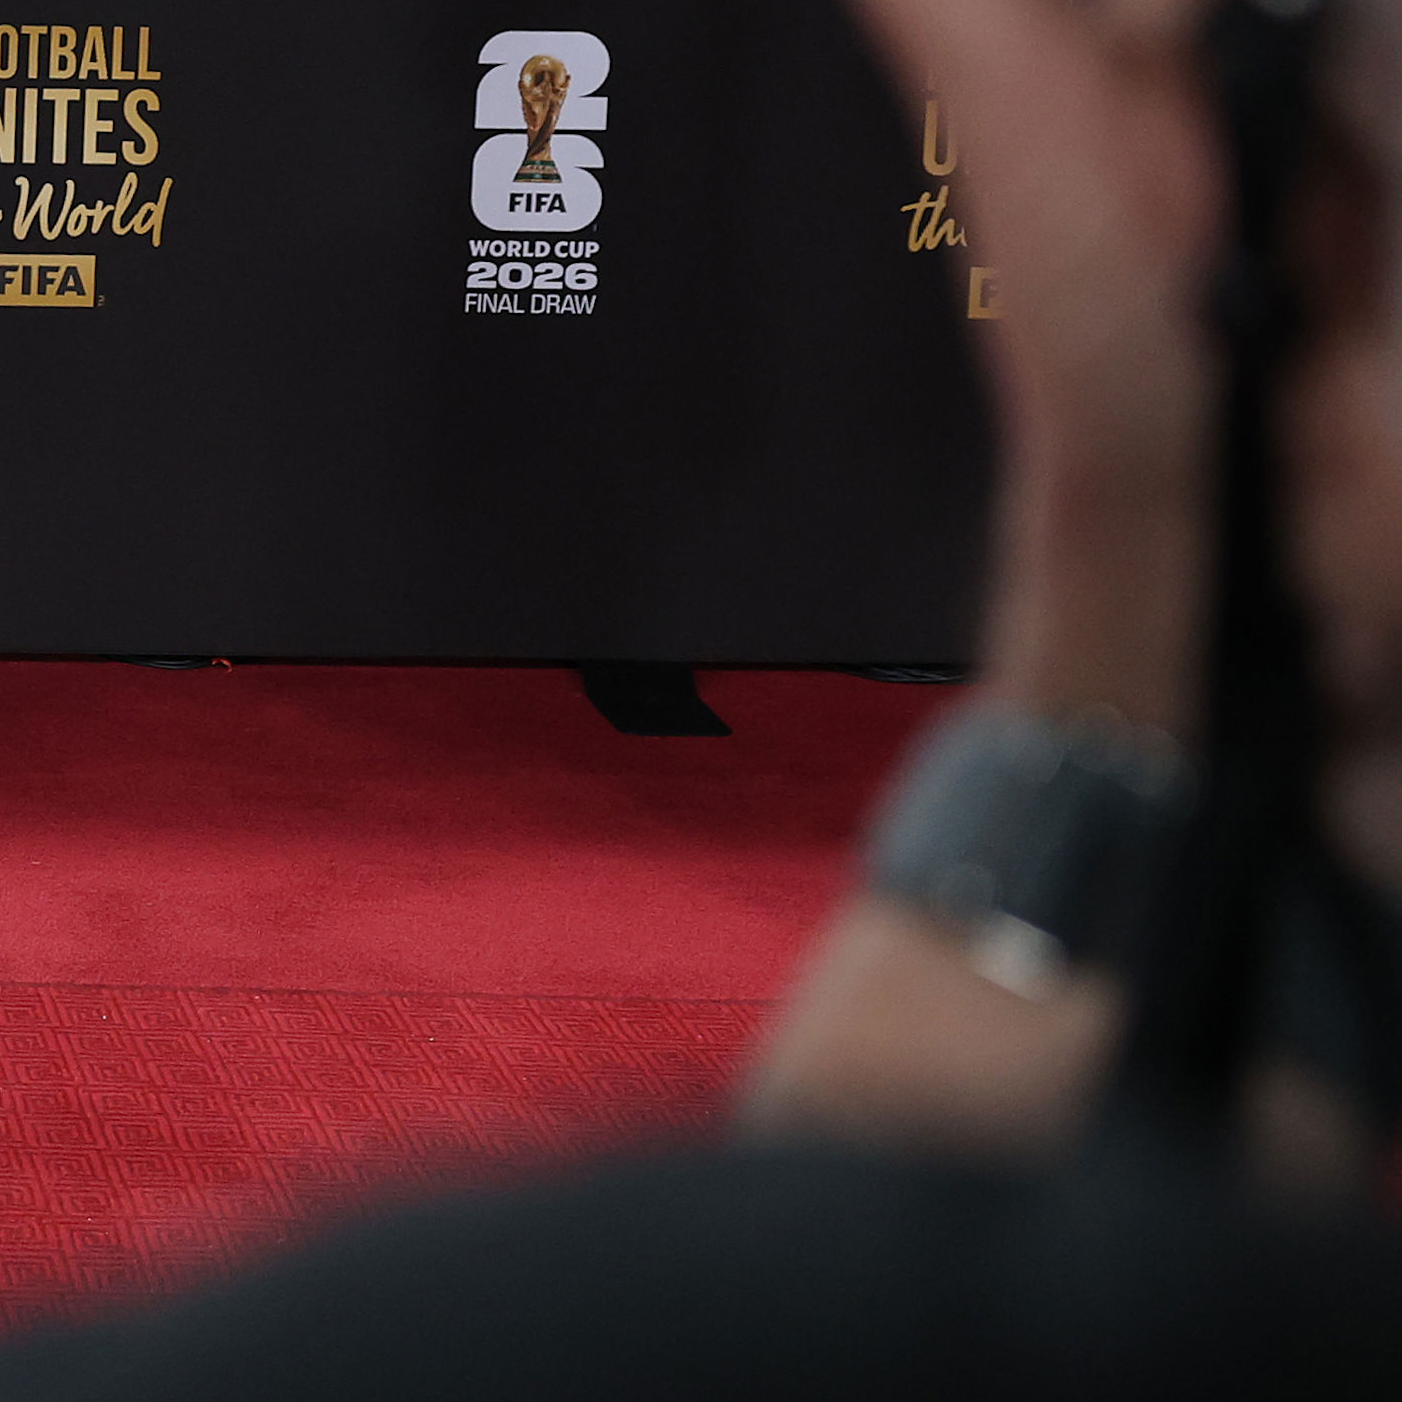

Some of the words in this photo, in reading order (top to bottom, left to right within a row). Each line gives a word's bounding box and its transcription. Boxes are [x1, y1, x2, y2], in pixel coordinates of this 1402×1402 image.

[13, 172, 172, 247] World
[509, 193, 566, 212] FIFA
[900, 185, 967, 252] th
[469, 240, 550, 257] WORLD
[555, 241, 599, 258] CUP
[467, 262, 597, 290] 2026
[465, 293, 525, 313] FINAL
[531, 294, 596, 314] DRAW
